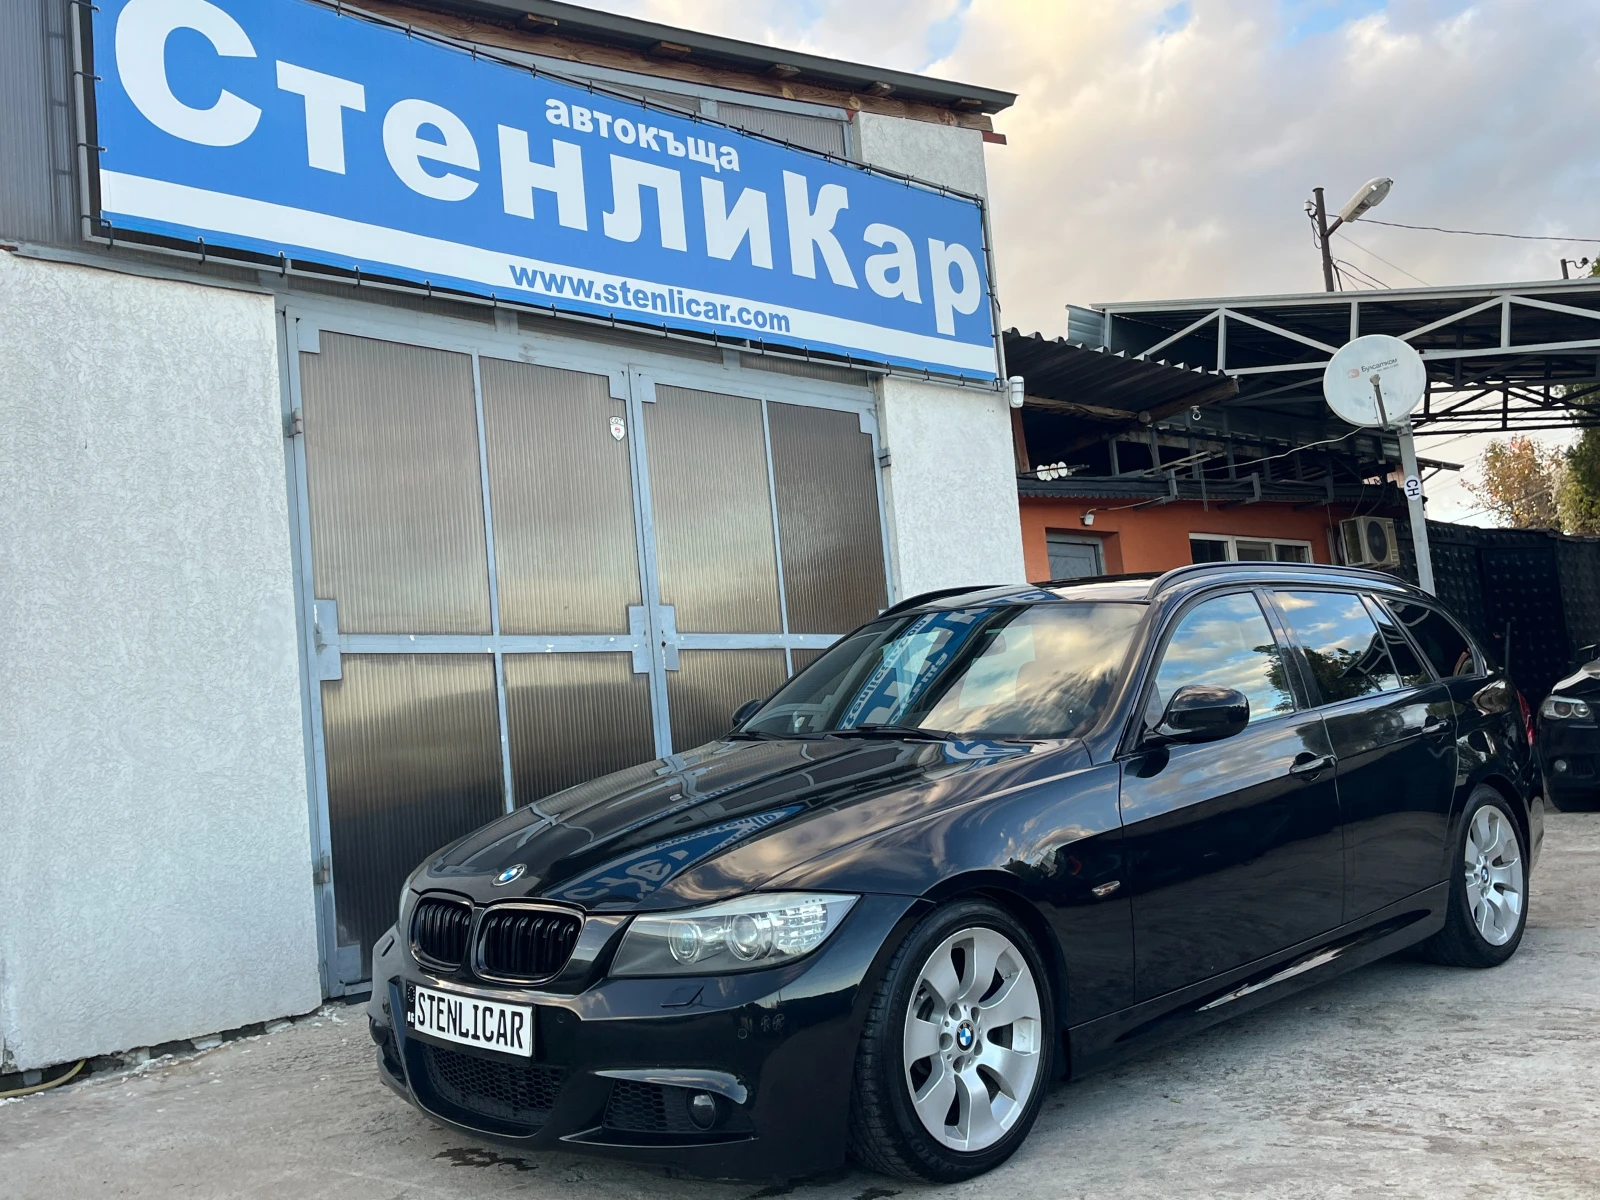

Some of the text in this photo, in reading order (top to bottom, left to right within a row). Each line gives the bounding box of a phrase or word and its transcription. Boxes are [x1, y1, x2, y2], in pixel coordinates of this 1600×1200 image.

[115, 0, 981, 335] СтенлиКар
[545, 98, 740, 172] автокъща
[509, 265, 791, 332] www.stenlicar.com
[1406, 479, 1420, 497] CH
[417, 991, 523, 1049] STENLICAR
